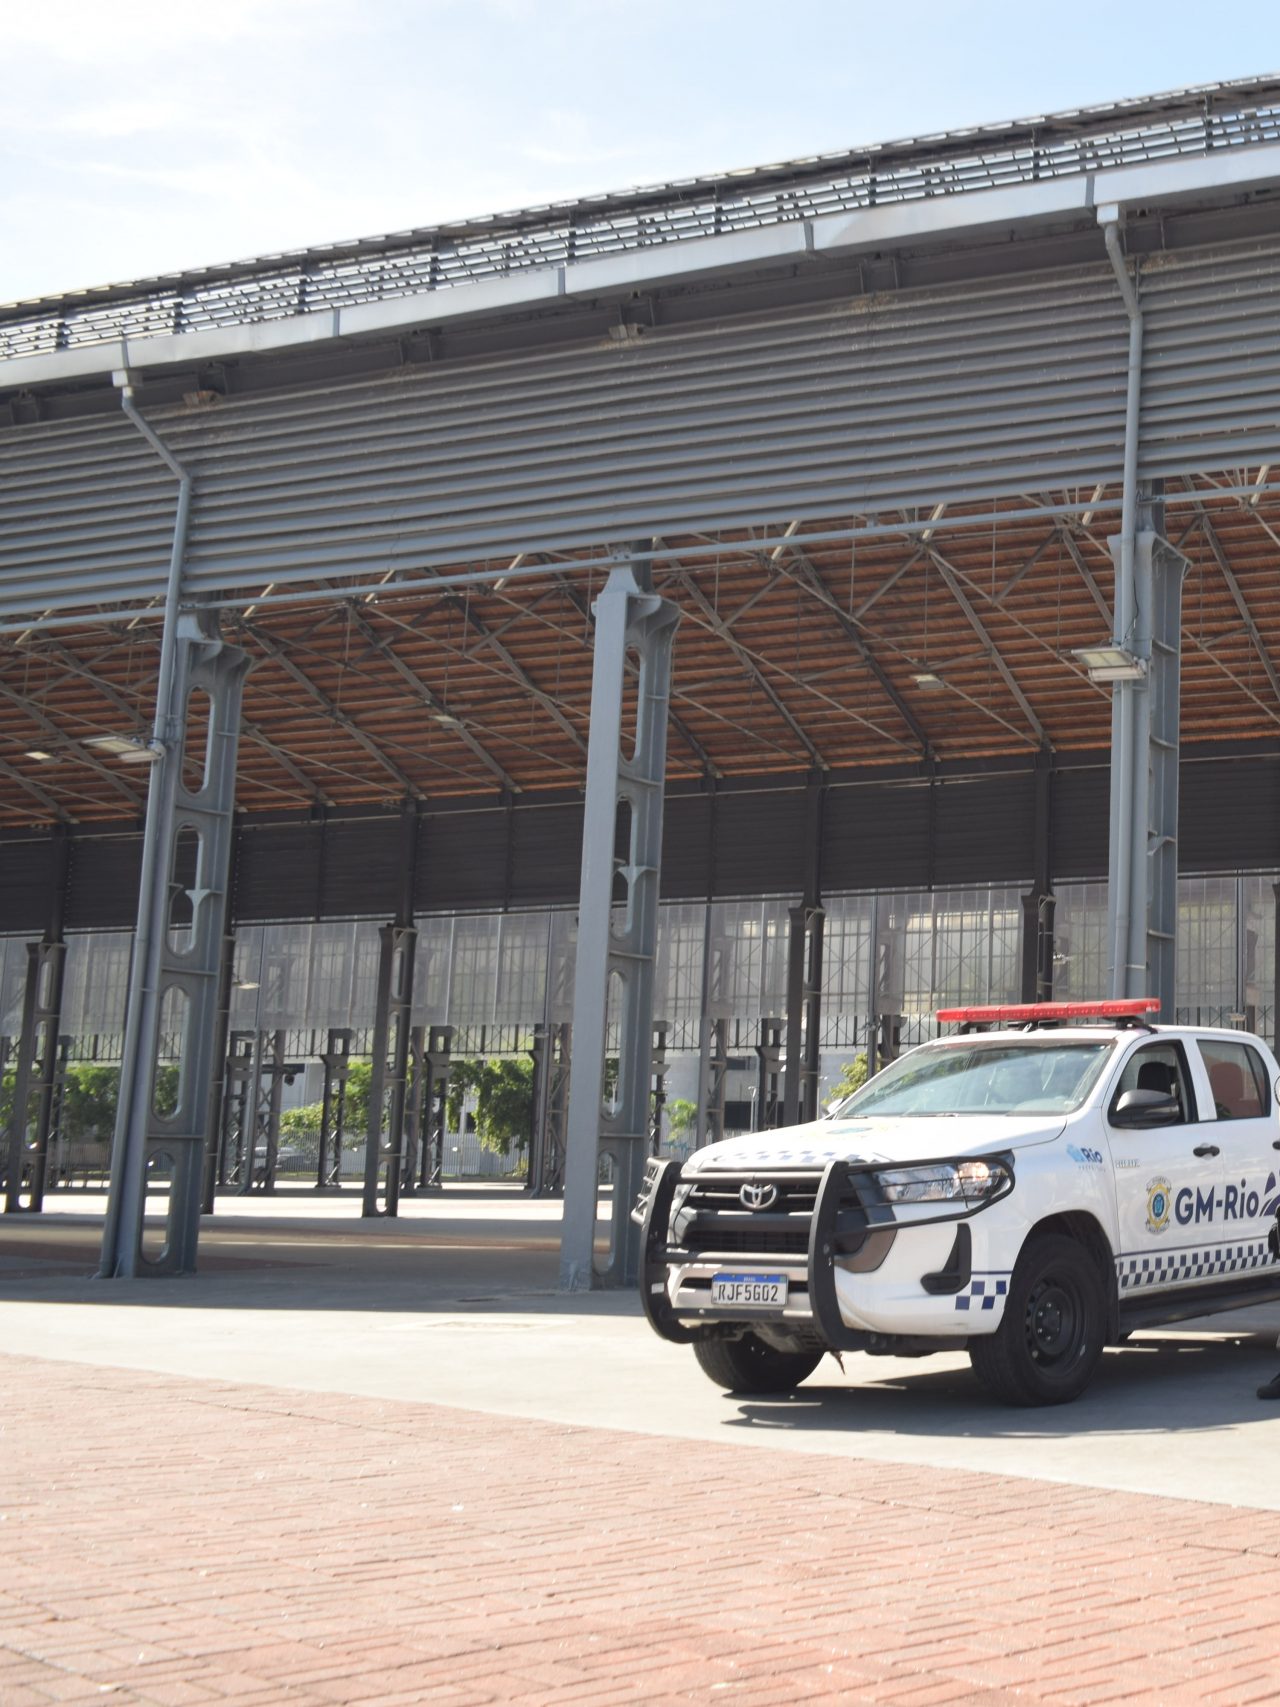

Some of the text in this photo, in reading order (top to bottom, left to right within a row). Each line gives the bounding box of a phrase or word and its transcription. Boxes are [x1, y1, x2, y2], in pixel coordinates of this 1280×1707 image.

[1081, 1148, 1103, 1164] Rio
[1175, 1178, 1259, 1225] GM-Rio
[718, 1284, 779, 1302] RJF5G02
